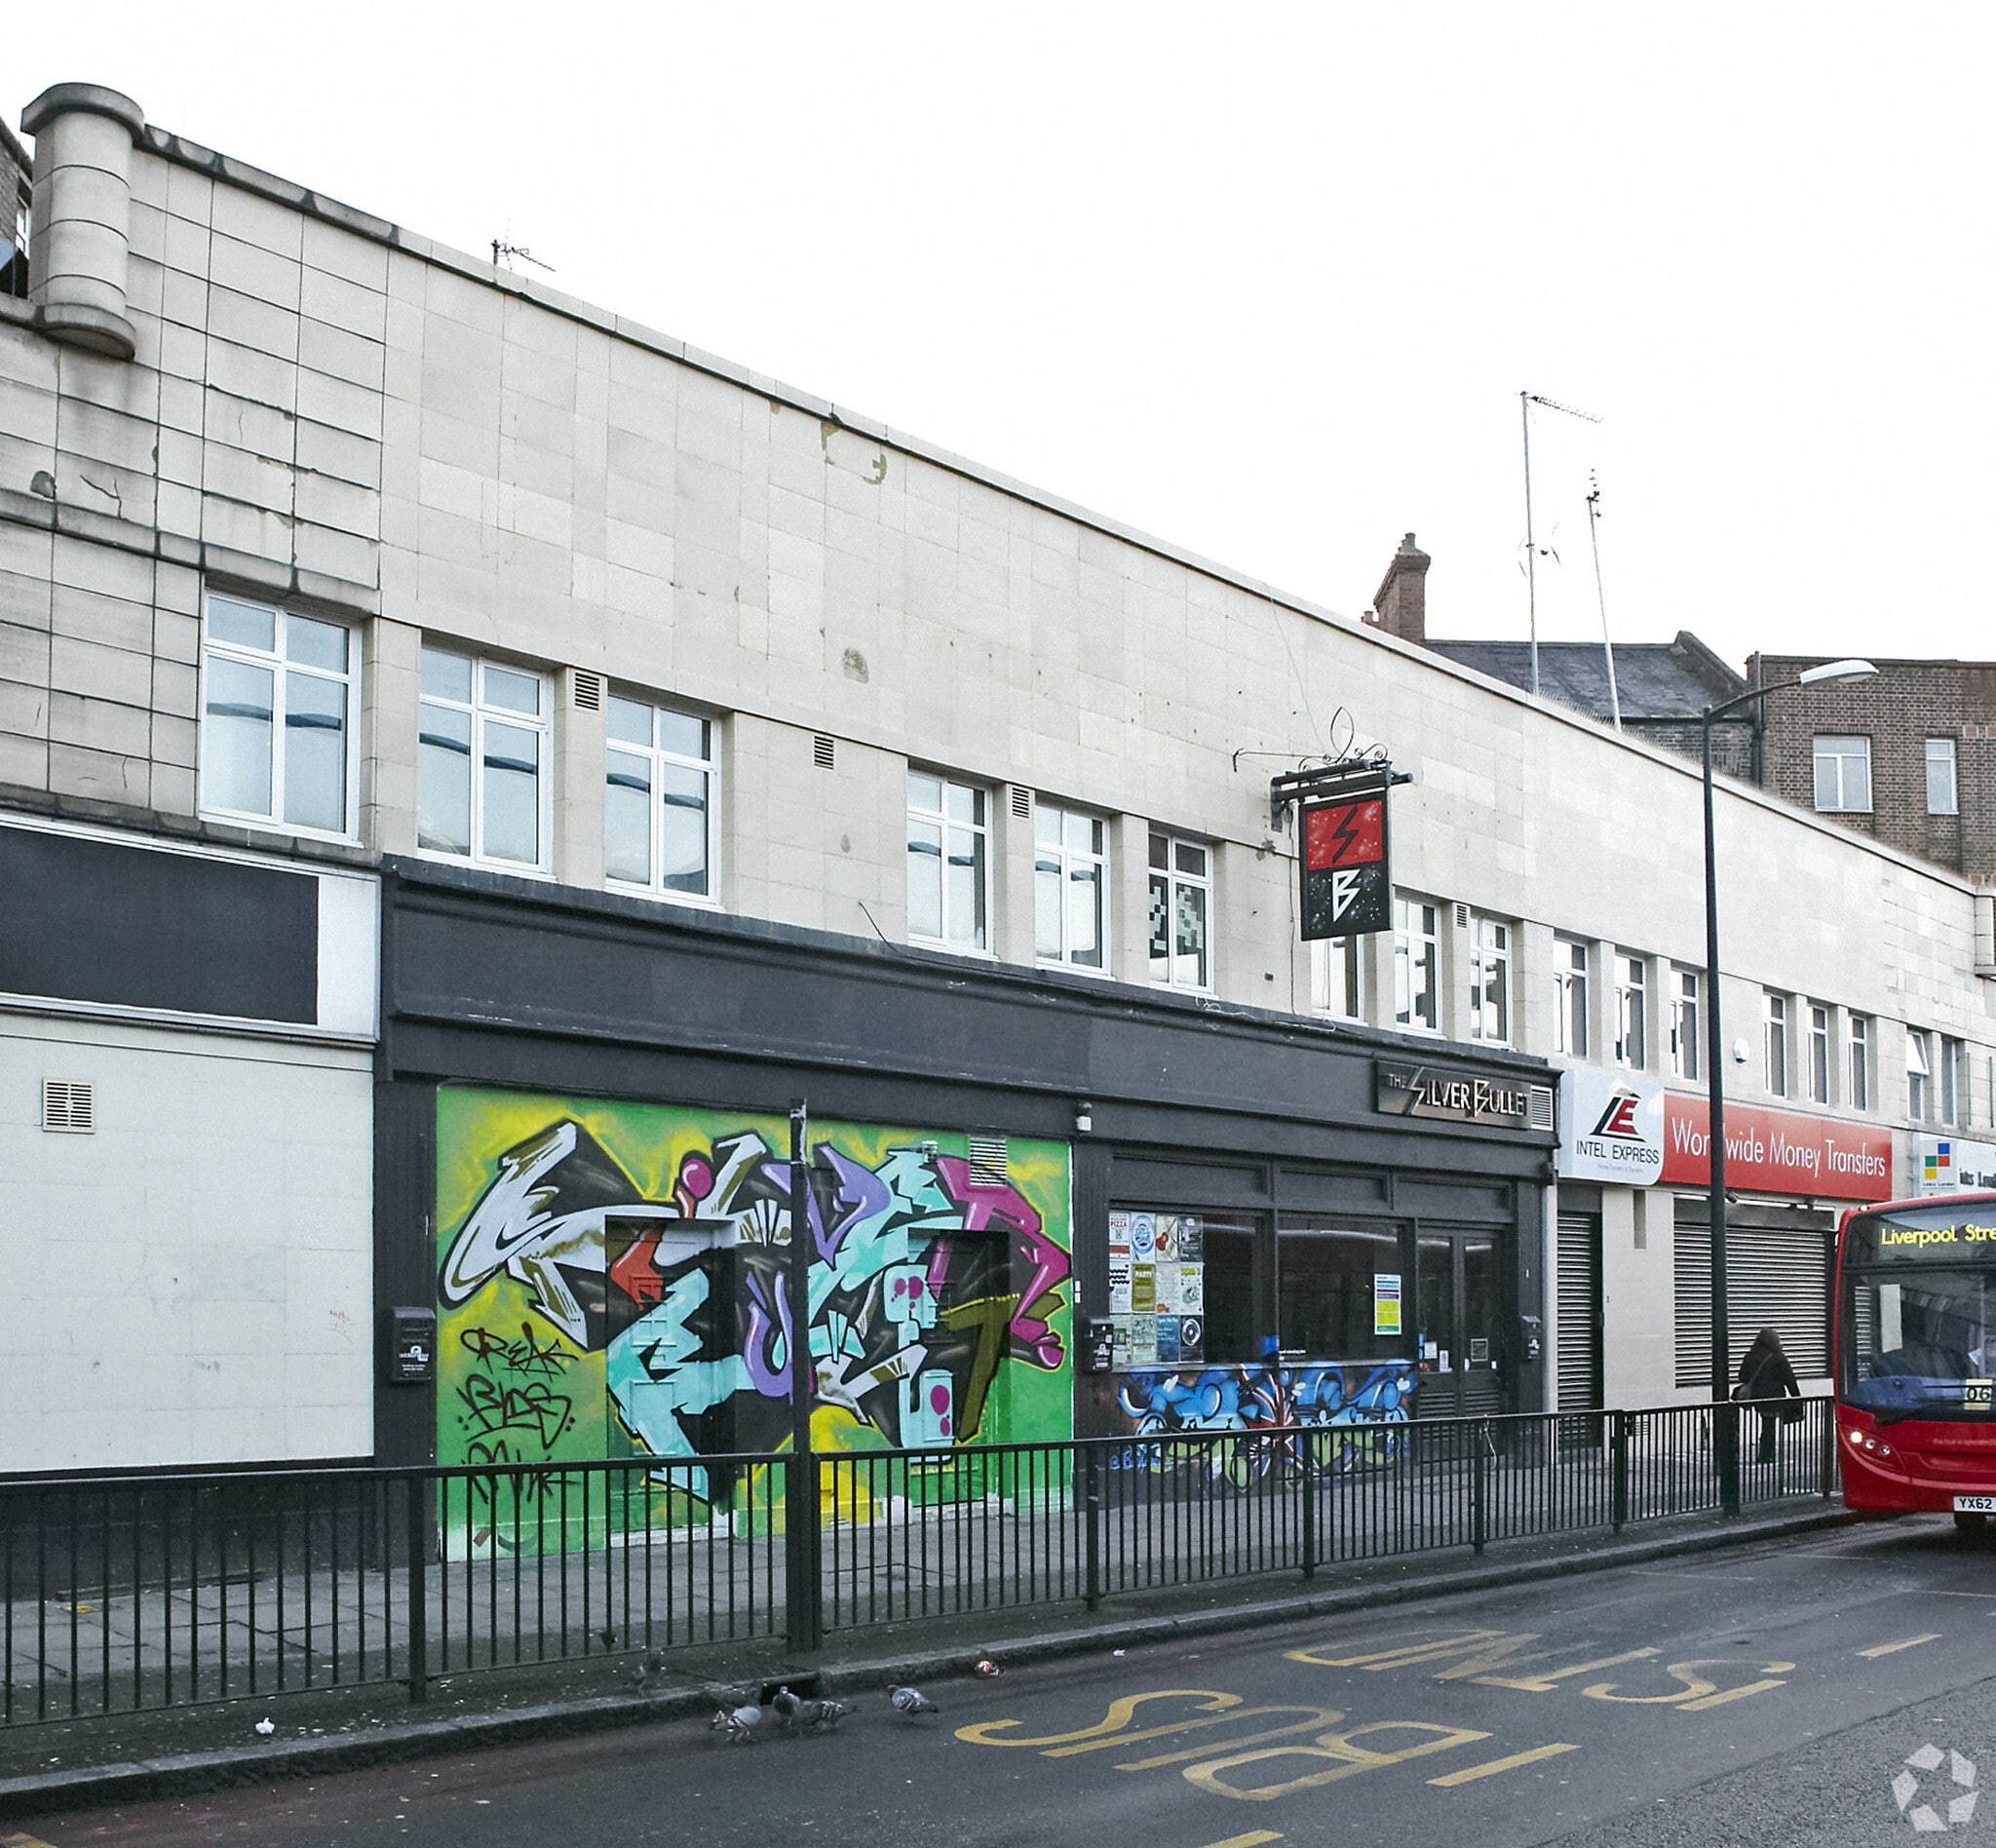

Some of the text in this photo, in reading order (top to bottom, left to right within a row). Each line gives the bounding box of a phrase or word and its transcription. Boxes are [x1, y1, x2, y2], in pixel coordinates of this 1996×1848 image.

[1332, 868, 1361, 922] B
[1388, 1066, 1529, 1117] THE SILVER BULLET
[1576, 1139, 1660, 1165] INTEL EXPRESS
[1671, 1117, 1885, 1177] Worwide Money Transfers
[1881, 1223, 1996, 1248] Liverpool Stre
[1966, 1387, 1991, 1402] 06
[1959, 1498, 1992, 1510] YX62
[954, 1689, 1493, 1800] BUS
